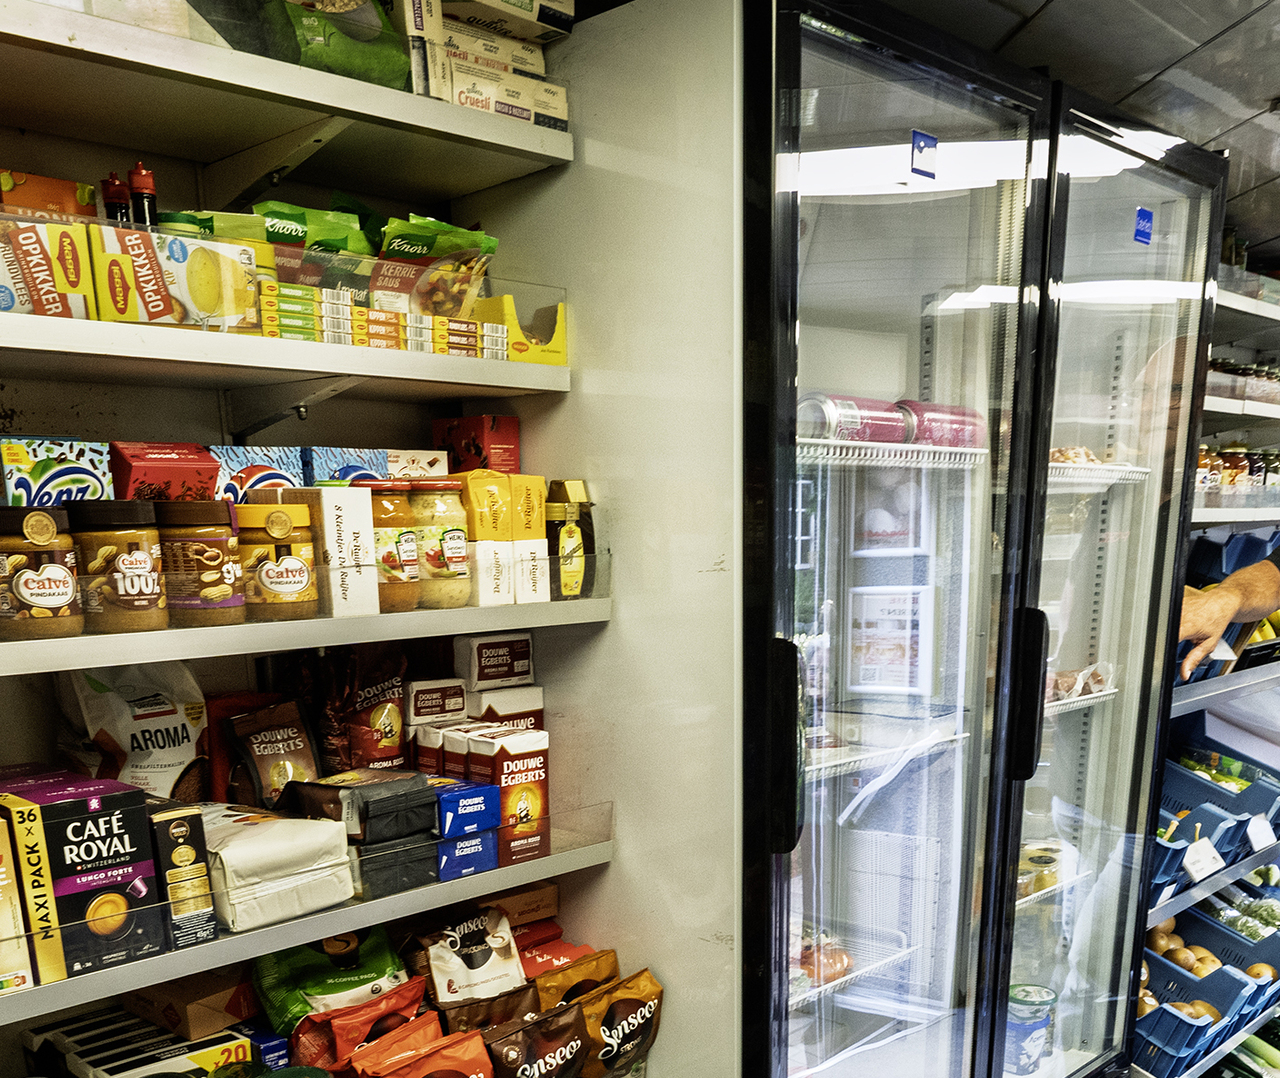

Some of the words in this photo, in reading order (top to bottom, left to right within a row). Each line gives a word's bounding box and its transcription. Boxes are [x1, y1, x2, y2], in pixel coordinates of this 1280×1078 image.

[458, 91, 490, 110] Cruesli
[265, 217, 307, 237] Knorr
[391, 239, 431, 255] Knorr
[18, 231, 63, 316] OPKIKKER
[127, 232, 164, 313] OPKIKKER
[381, 264, 418, 279] KERRIE
[265, 566, 305, 580] Calvé
[25, 576, 69, 590] Calvé
[113, 571, 160, 596] 100%
[29, 591, 69, 599] PINDAKAAS
[481, 656, 512, 666] EGBERTS
[357, 676, 403, 701] DOUWE
[354, 687, 404, 711] EGBERTS
[130, 723, 191, 751] AROMA
[249, 726, 299, 745] DOUWE
[253, 738, 304, 756] EGBERTS
[503, 756, 544, 773] DOUWE
[501, 769, 545, 787] EGBERTS
[65, 810, 125, 843] CAFÉ
[63, 835, 137, 865] ROYAL
[82, 856, 131, 871] SWITZERLAND
[446, 915, 489, 953] Senseo
[598, 996, 658, 1060] Senseo
